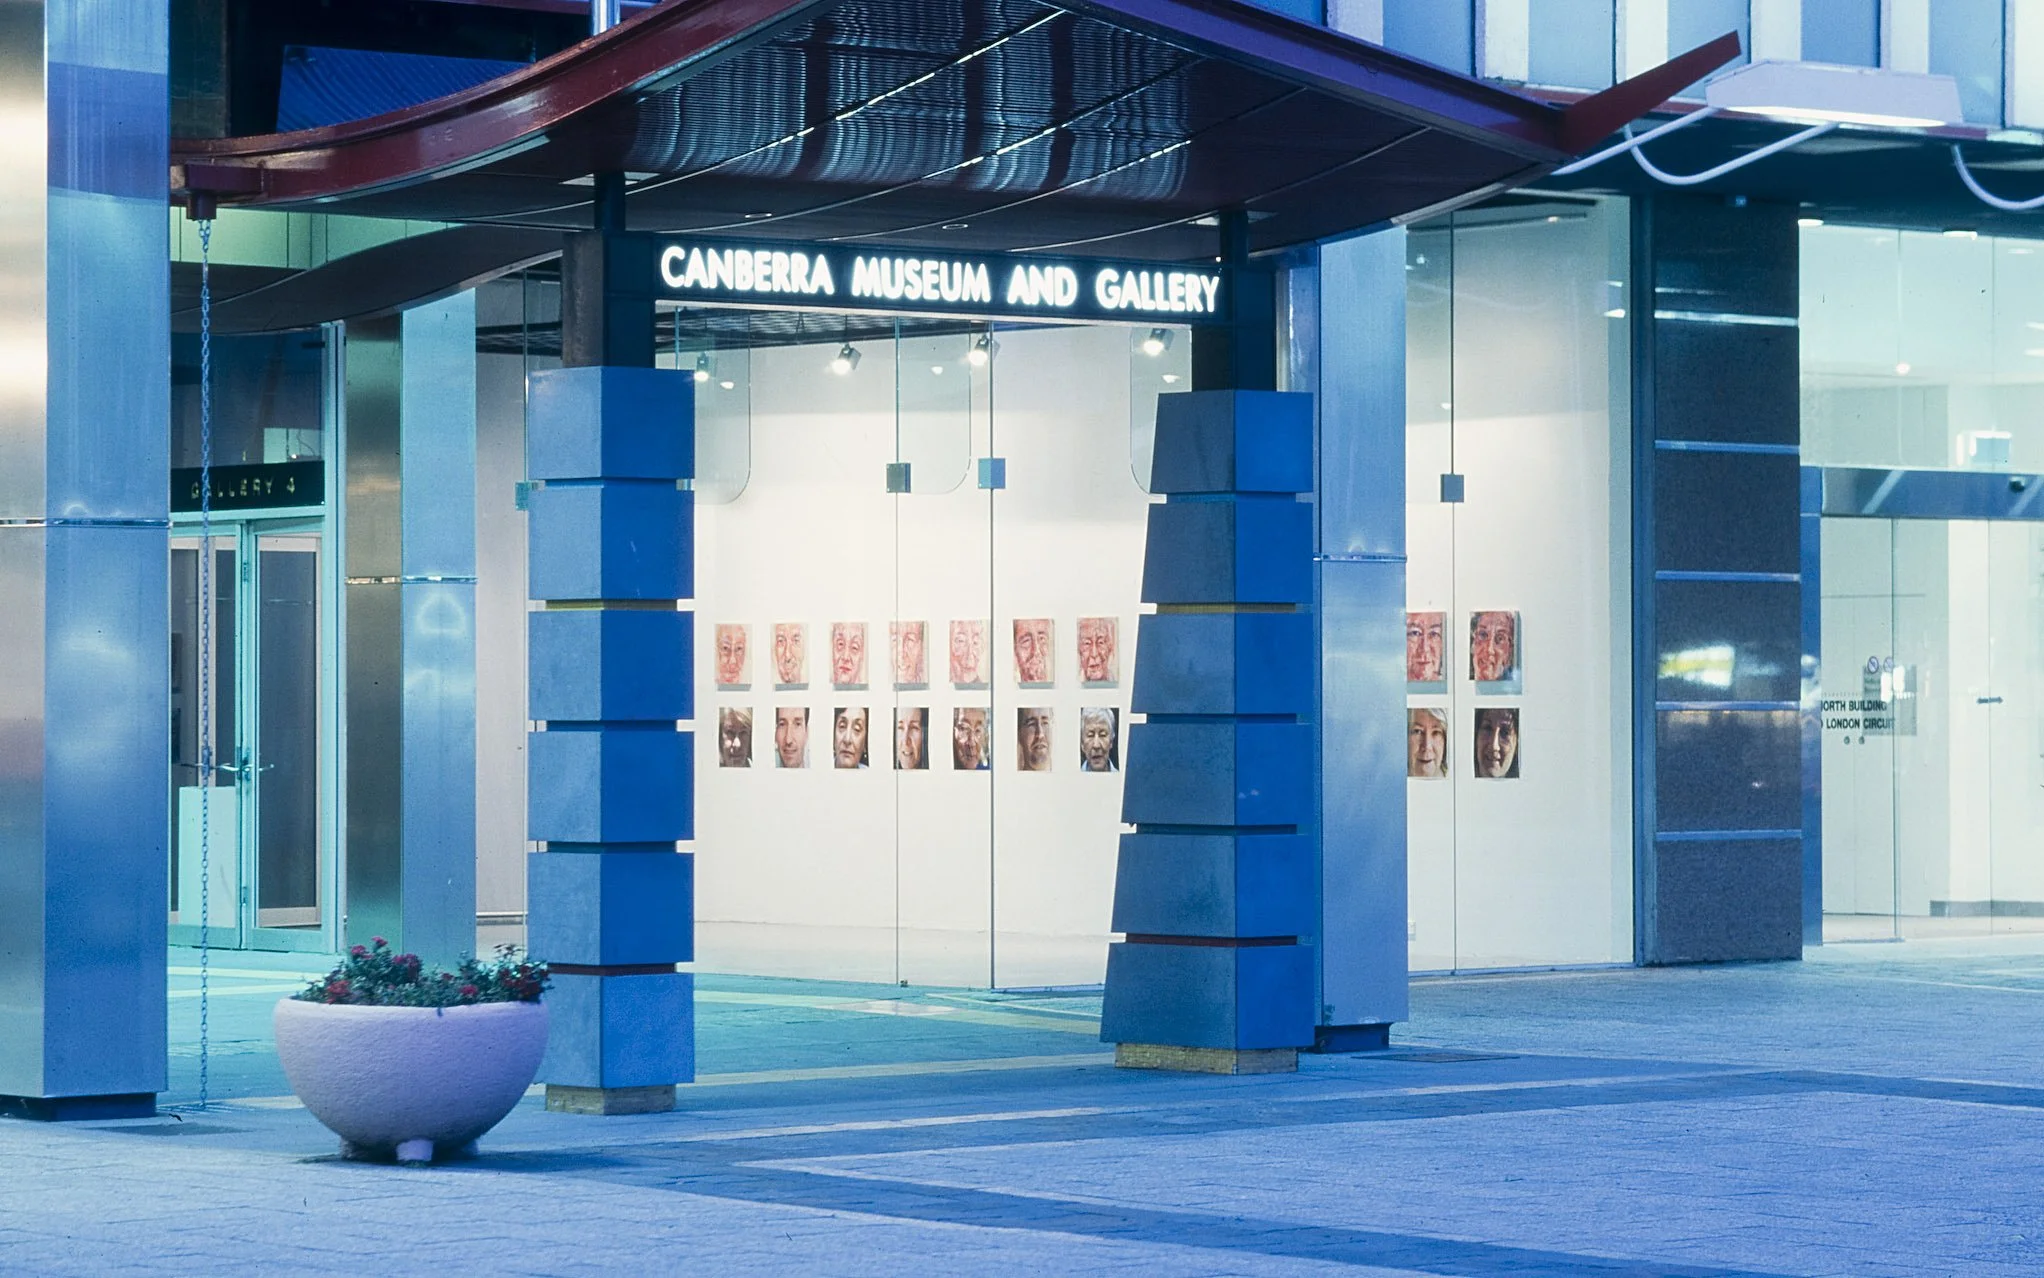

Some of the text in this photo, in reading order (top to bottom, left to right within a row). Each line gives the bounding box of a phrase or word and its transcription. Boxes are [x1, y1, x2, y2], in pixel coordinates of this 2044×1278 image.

[660, 246, 1221, 313] CANBERRA MUSEUM AND GALLERY
[286, 476, 296, 494] 4
[1821, 700, 1887, 712] ORTH BUILDING
[1826, 718, 1860, 729] LONDON
